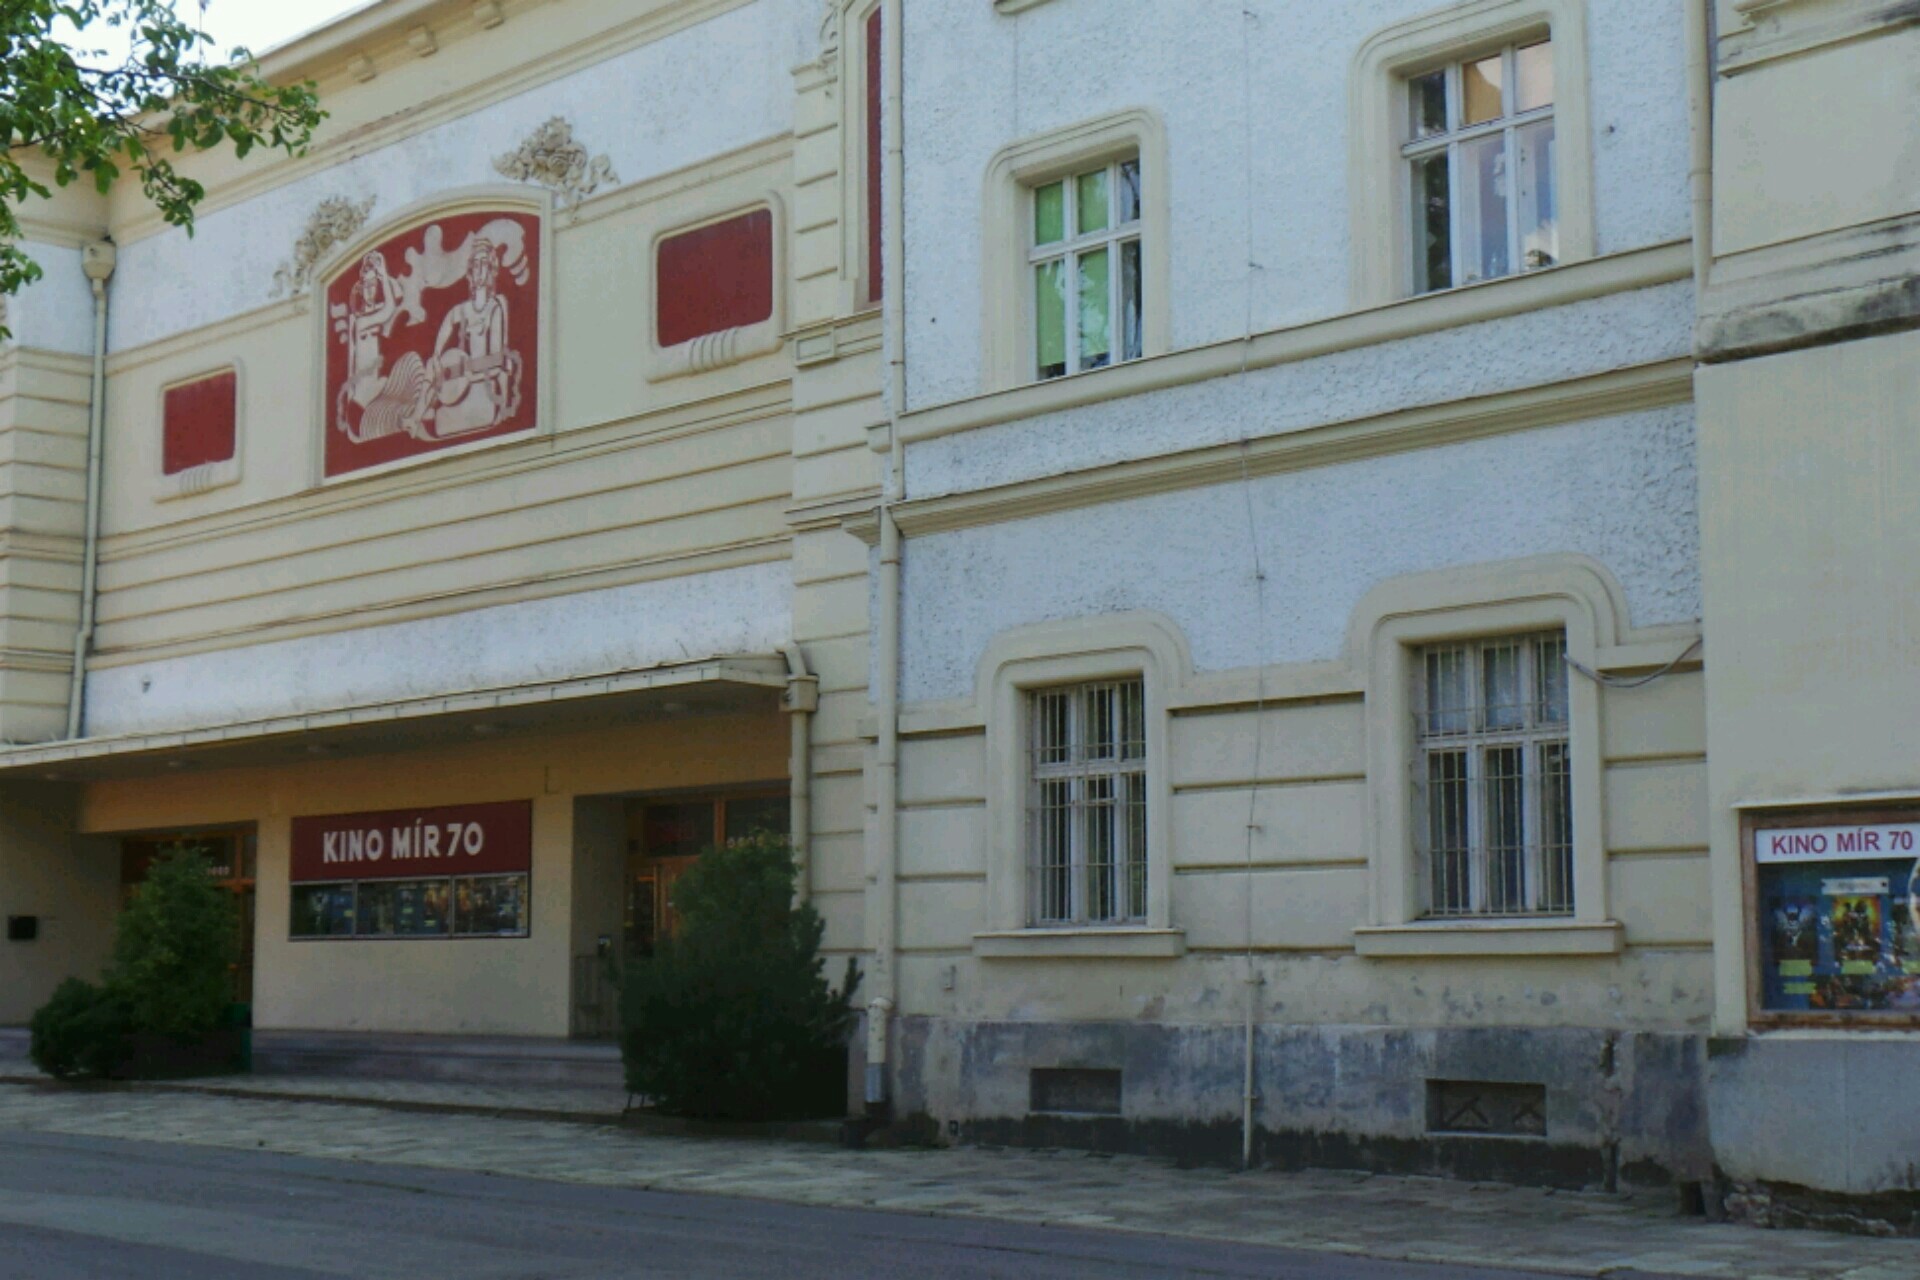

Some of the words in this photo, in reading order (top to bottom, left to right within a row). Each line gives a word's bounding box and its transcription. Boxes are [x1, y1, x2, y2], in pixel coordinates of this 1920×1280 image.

[323, 829, 384, 864] KINO
[391, 817, 440, 860] MÍR
[446, 821, 484, 857] 70
[1771, 833, 1828, 855] KINO
[1836, 828, 1880, 853] MÍR
[1888, 830, 1913, 850] 70
